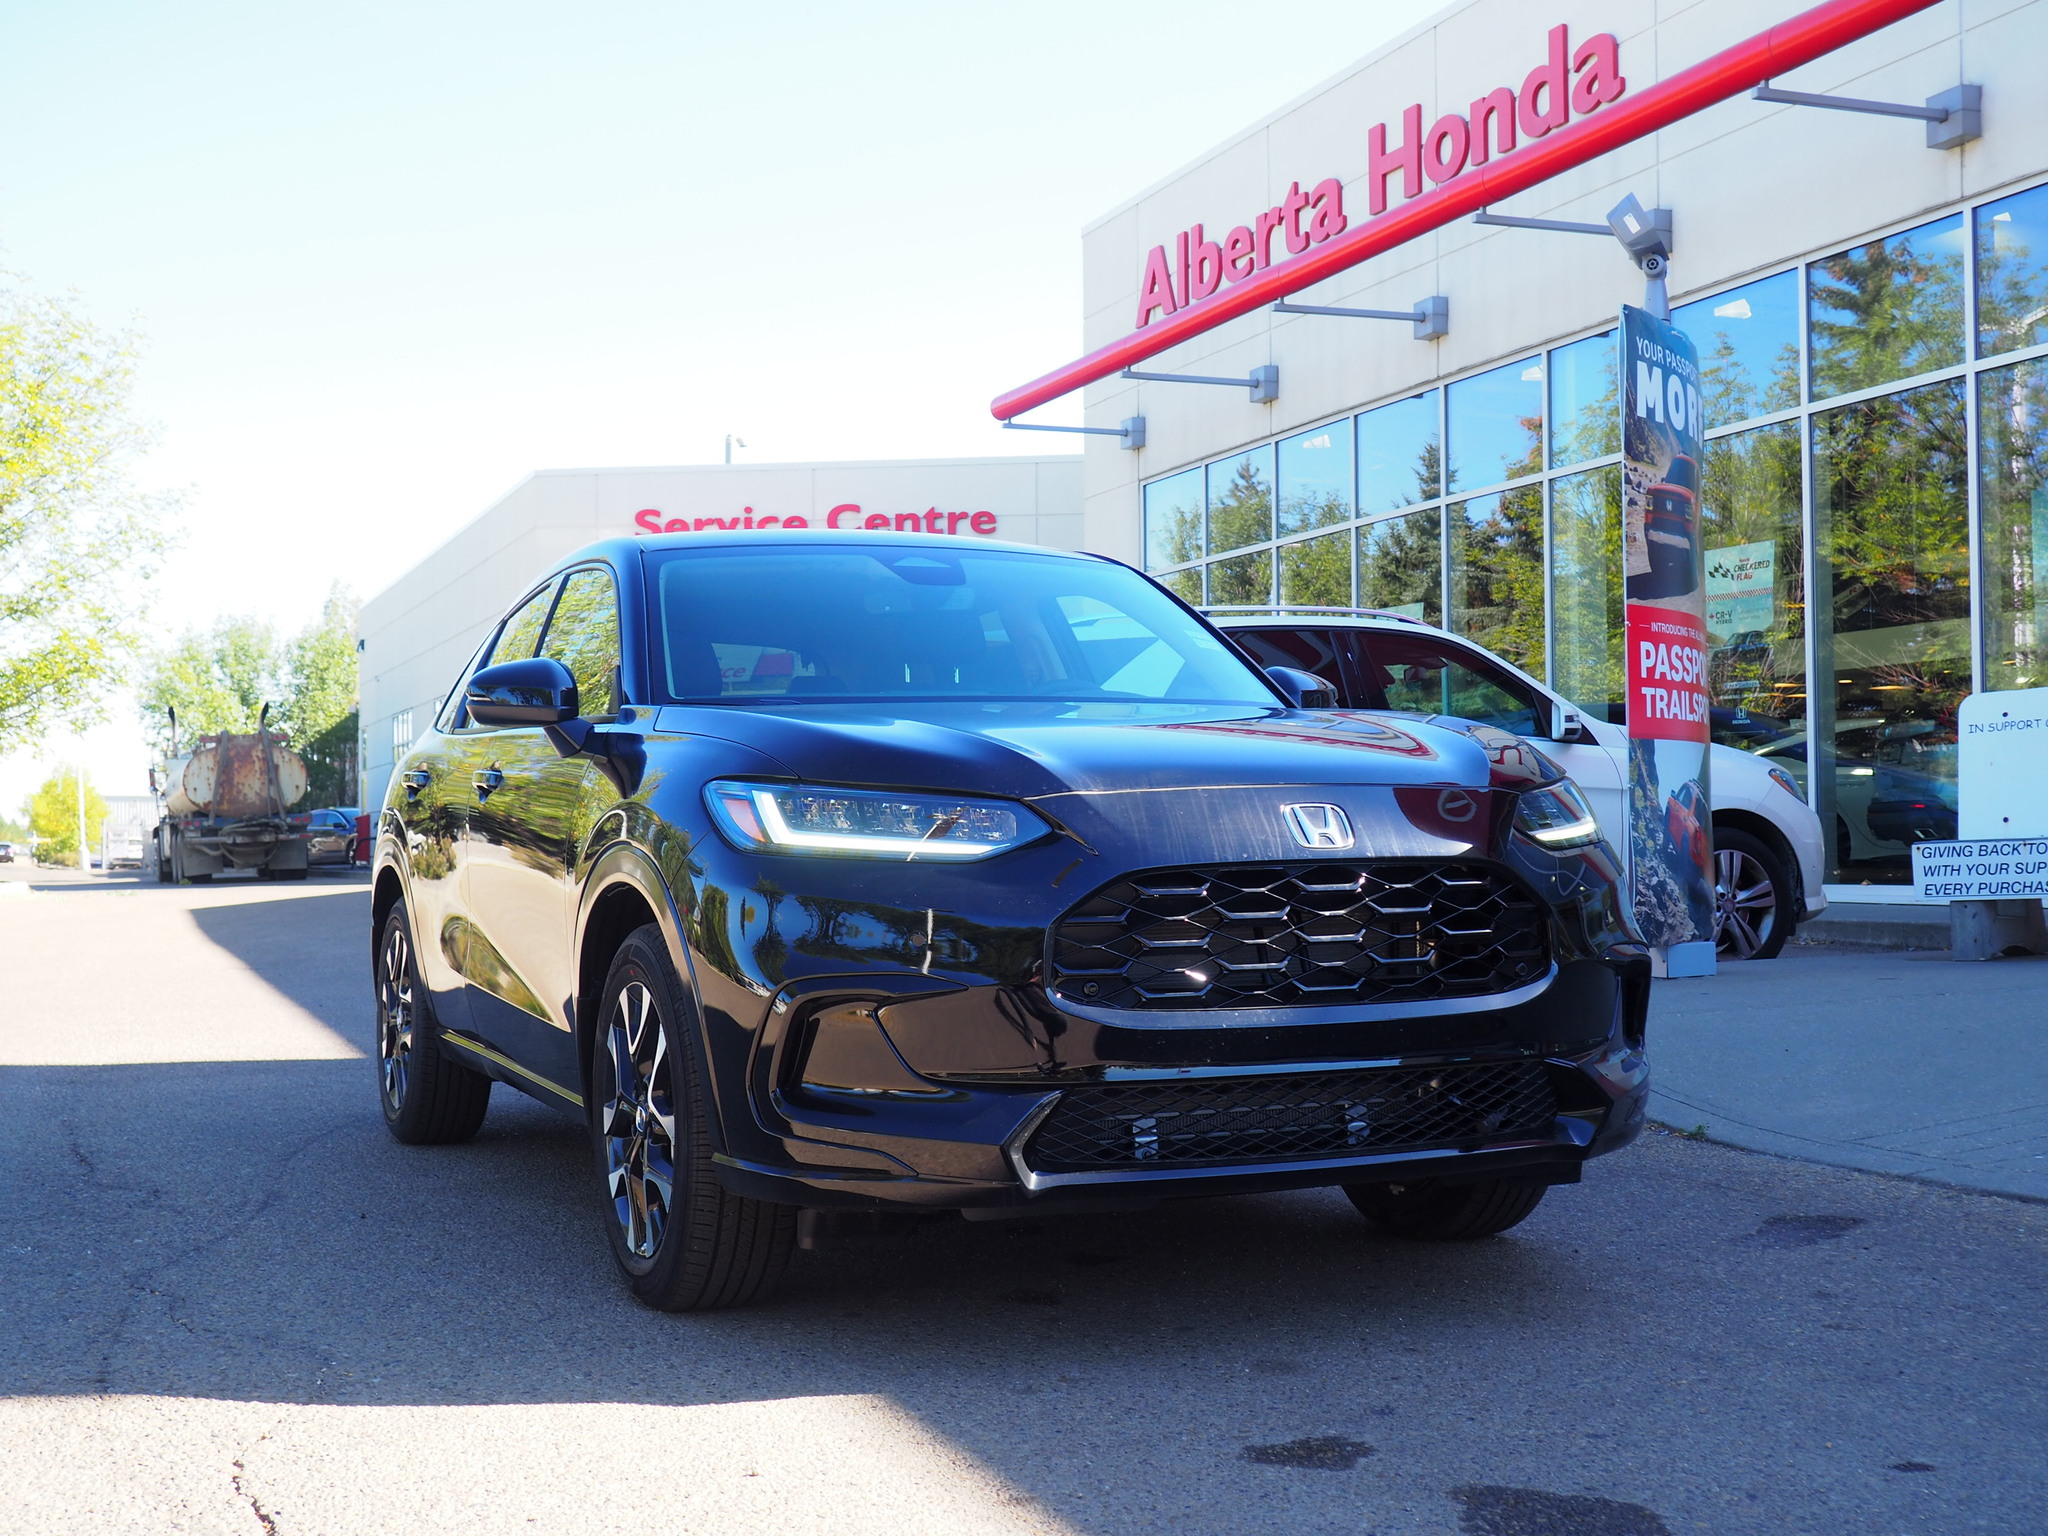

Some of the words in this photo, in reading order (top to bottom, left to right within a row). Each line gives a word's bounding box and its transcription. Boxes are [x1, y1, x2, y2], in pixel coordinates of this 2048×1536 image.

[1136, 178, 1347, 330] Alberta
[1368, 23, 1626, 216] Honda
[1636, 335, 1664, 365] YOUR
[827, 503, 997, 535] Centre
[1733, 560, 1770, 573] CHECKERED
[1736, 572, 1753, 581] FLAG
[1715, 609, 1733, 620] CR-V
[1651, 621, 1688, 637] INTRODUCING
[1968, 723, 1984, 734] IN
[1987, 718, 2042, 733] SUPPORT
[1921, 845, 1973, 859] GIVING
[1978, 843, 2021, 857] BACK
[2027, 842, 2048, 855] TO
[1923, 864, 1961, 877] WITH
[1966, 862, 2010, 876] YOUR
[1924, 882, 1974, 896] EVERY
